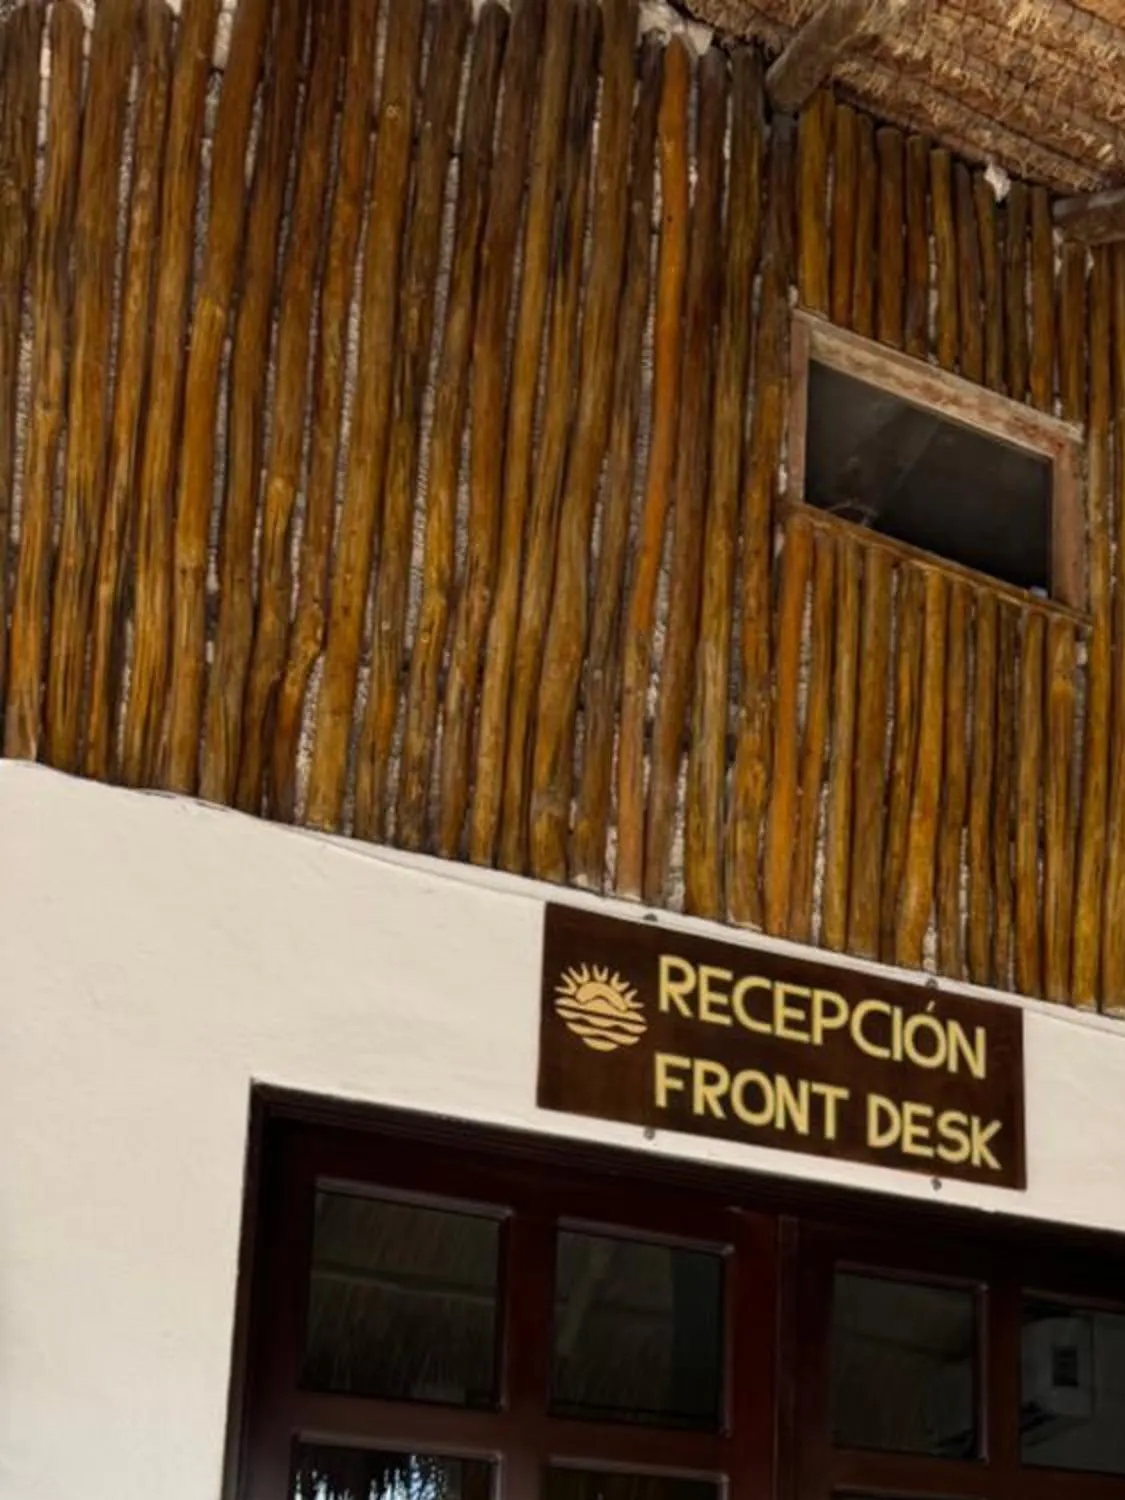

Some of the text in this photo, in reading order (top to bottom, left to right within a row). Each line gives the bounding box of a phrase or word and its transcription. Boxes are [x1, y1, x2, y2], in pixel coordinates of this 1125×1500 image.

[658, 954, 986, 1079] RECEPCIÓN
[654, 1052, 1001, 1170] FRONT DESK
